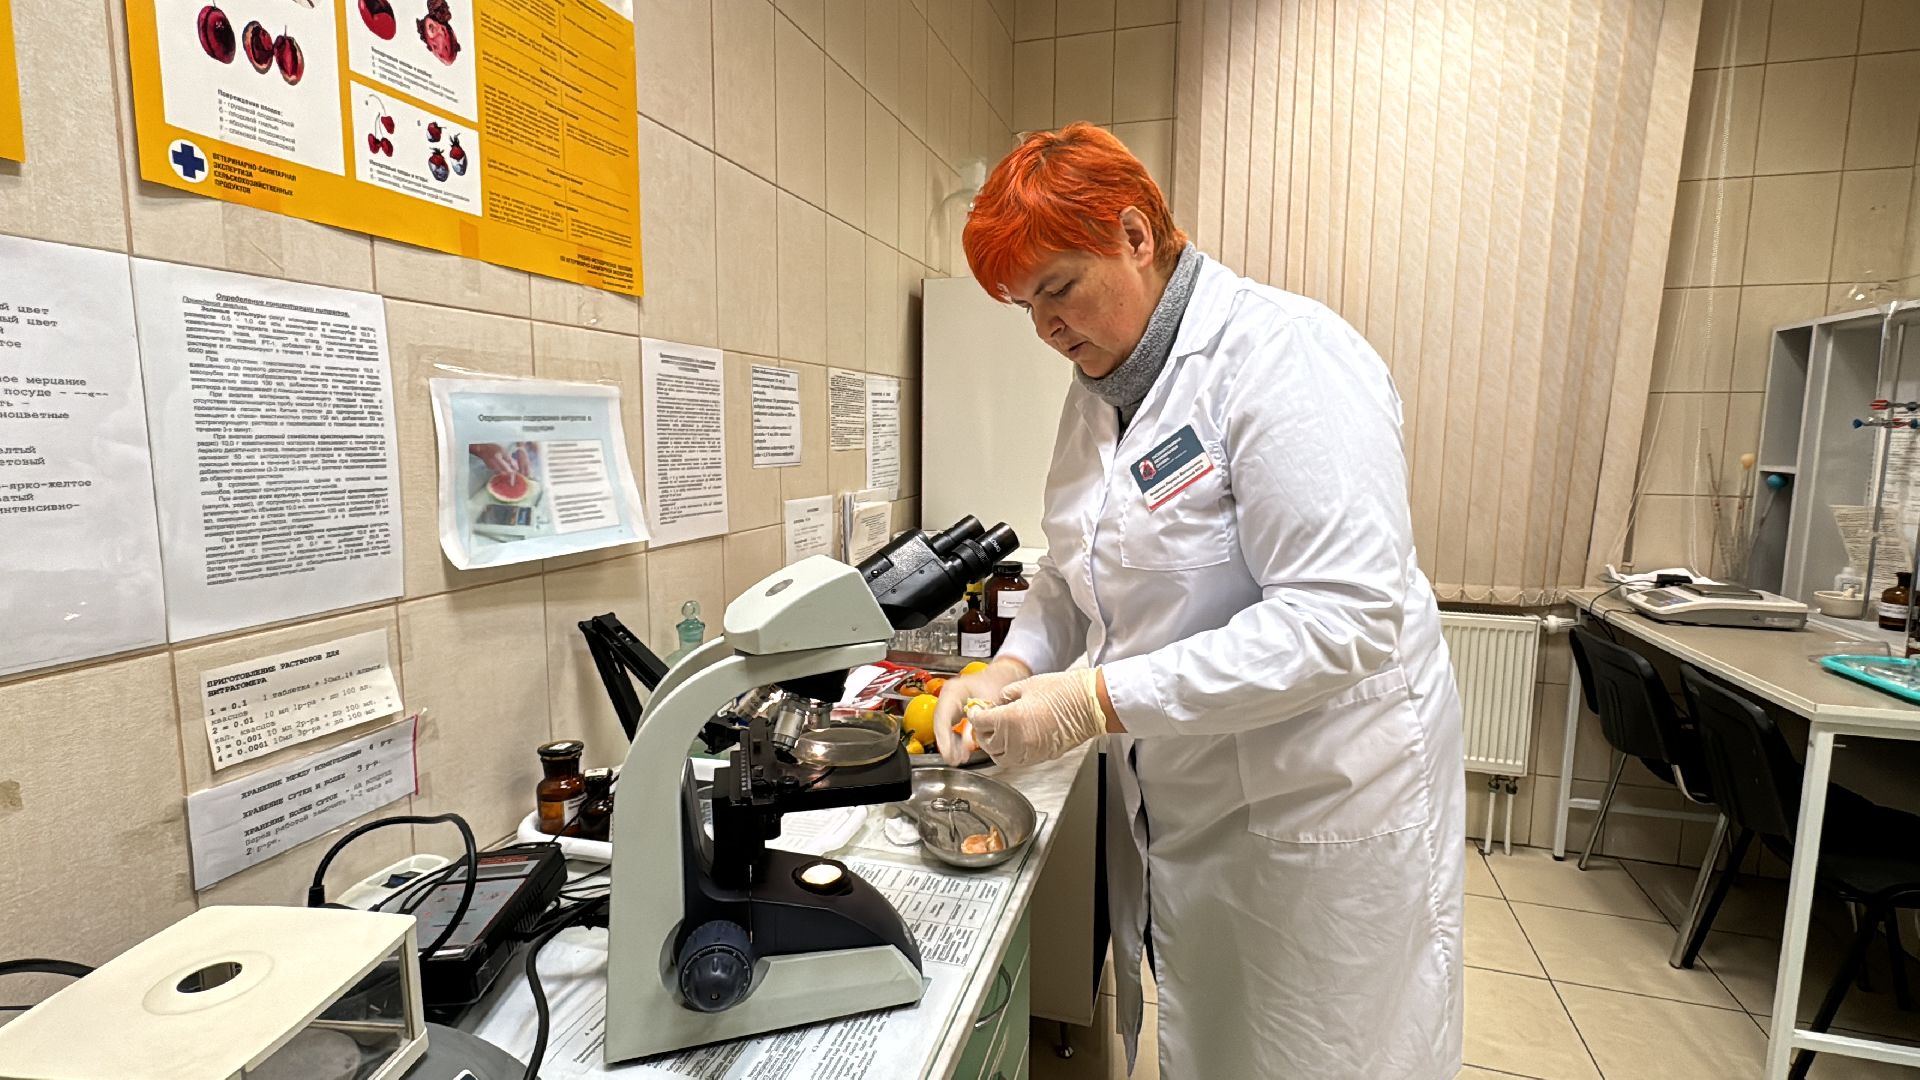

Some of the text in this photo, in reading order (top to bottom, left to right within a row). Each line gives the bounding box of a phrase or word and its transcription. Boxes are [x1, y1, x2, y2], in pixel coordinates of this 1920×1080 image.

[214, 162, 253, 177] ЭКСПЕРТИЗА
[214, 170, 293, 196] СЕЛЬСКОХОЗЯЙСТВЕННЫХ
[214, 178, 251, 194] ПРОДУКТОВ
[18, 306, 49, 315] цвет
[27, 318, 58, 328] цвет
[4, 388, 52, 398] посуде
[26, 376, 87, 387] мерцание
[207, 666, 276, 688] ПРИГОТОВЛЕНИЕ
[280, 654, 322, 670] РАСТВОРОВ
[208, 677, 267, 697] НИТРАТОМЕРА
[232, 700, 247, 710] 0.1
[272, 684, 310, 698] таблетка
[234, 717, 254, 728] 0.01
[264, 710, 274, 719] 10
[278, 707, 290, 715] мл
[343, 687, 356, 696] 100
[236, 734, 262, 746] 0.001
[268, 728, 277, 737] 10
[282, 724, 292, 732] мл
[296, 716, 320, 728] 2р-ра
[346, 703, 360, 713] 100
[237, 741, 268, 756] 0.0001
[348, 711, 362, 721] 100
[240, 778, 283, 800] ХРАНЕНИЕ
[286, 768, 311, 782] МЕЖДУ
[242, 798, 284, 819] ХРАНЕНИЕ
[288, 786, 312, 800] СУТКИ
[324, 773, 346, 786] БОЛЕЕ
[357, 764, 362, 772] 3
[244, 815, 285, 837] ХРАНЕНИЕ
[289, 804, 313, 818] БОЛЕЕ
[316, 793, 338, 806] СУТОК
[275, 814, 308, 835] работой
[246, 847, 252, 856] 2
